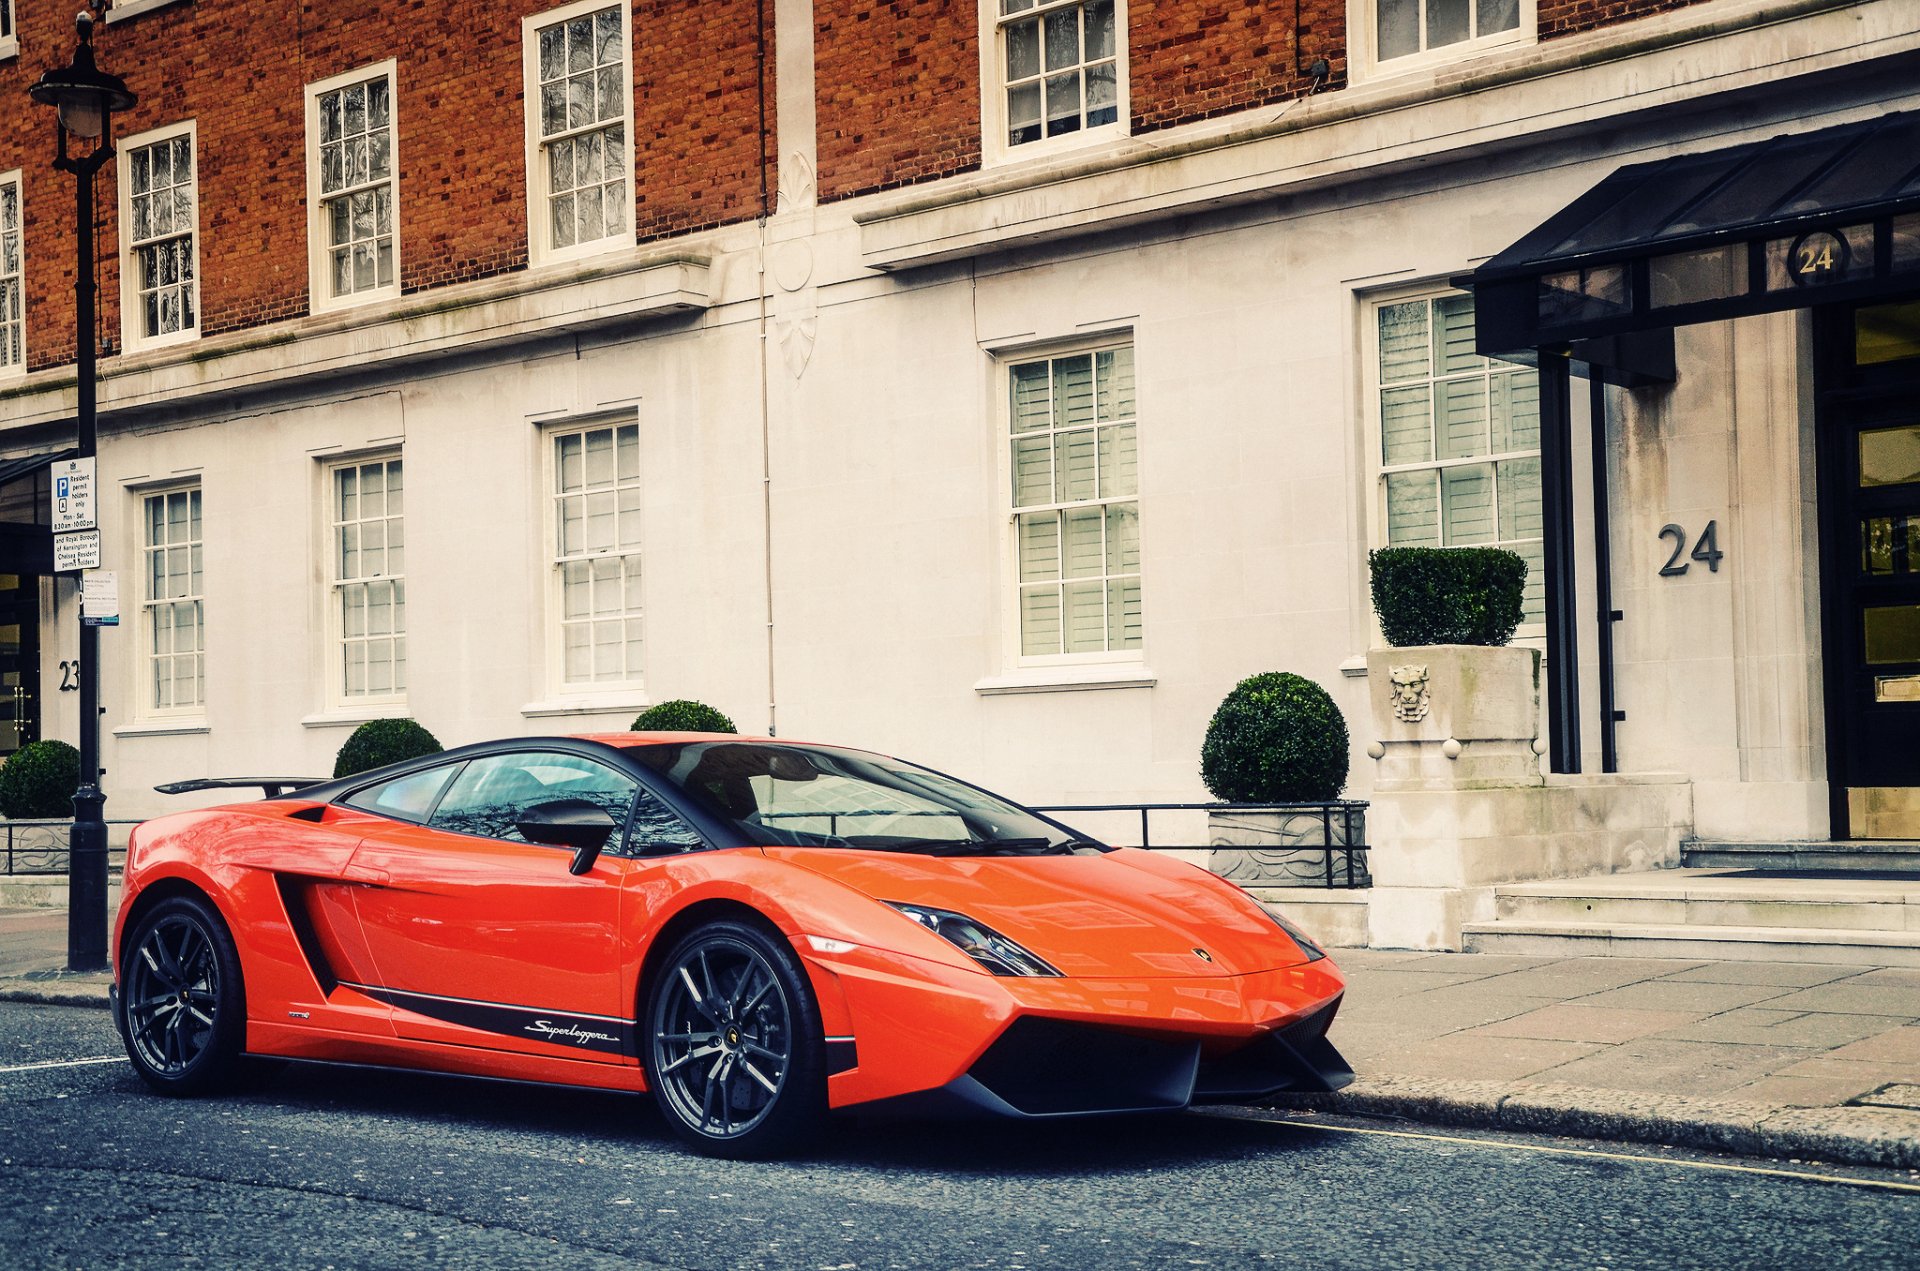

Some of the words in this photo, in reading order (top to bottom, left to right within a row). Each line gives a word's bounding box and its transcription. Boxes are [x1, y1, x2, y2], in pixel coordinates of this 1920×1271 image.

[1799, 241, 1834, 274] 24
[70, 474, 90, 482] Resident
[72, 483, 87, 492] permit
[75, 500, 85, 508] only
[66, 535, 78, 543] Royal
[79, 533, 98, 541] Borough
[1658, 519, 1724, 577] 24
[77, 550, 97, 558] Resident
[59, 660, 80, 692] 23
[523, 1020, 621, 1044] Superleggera
